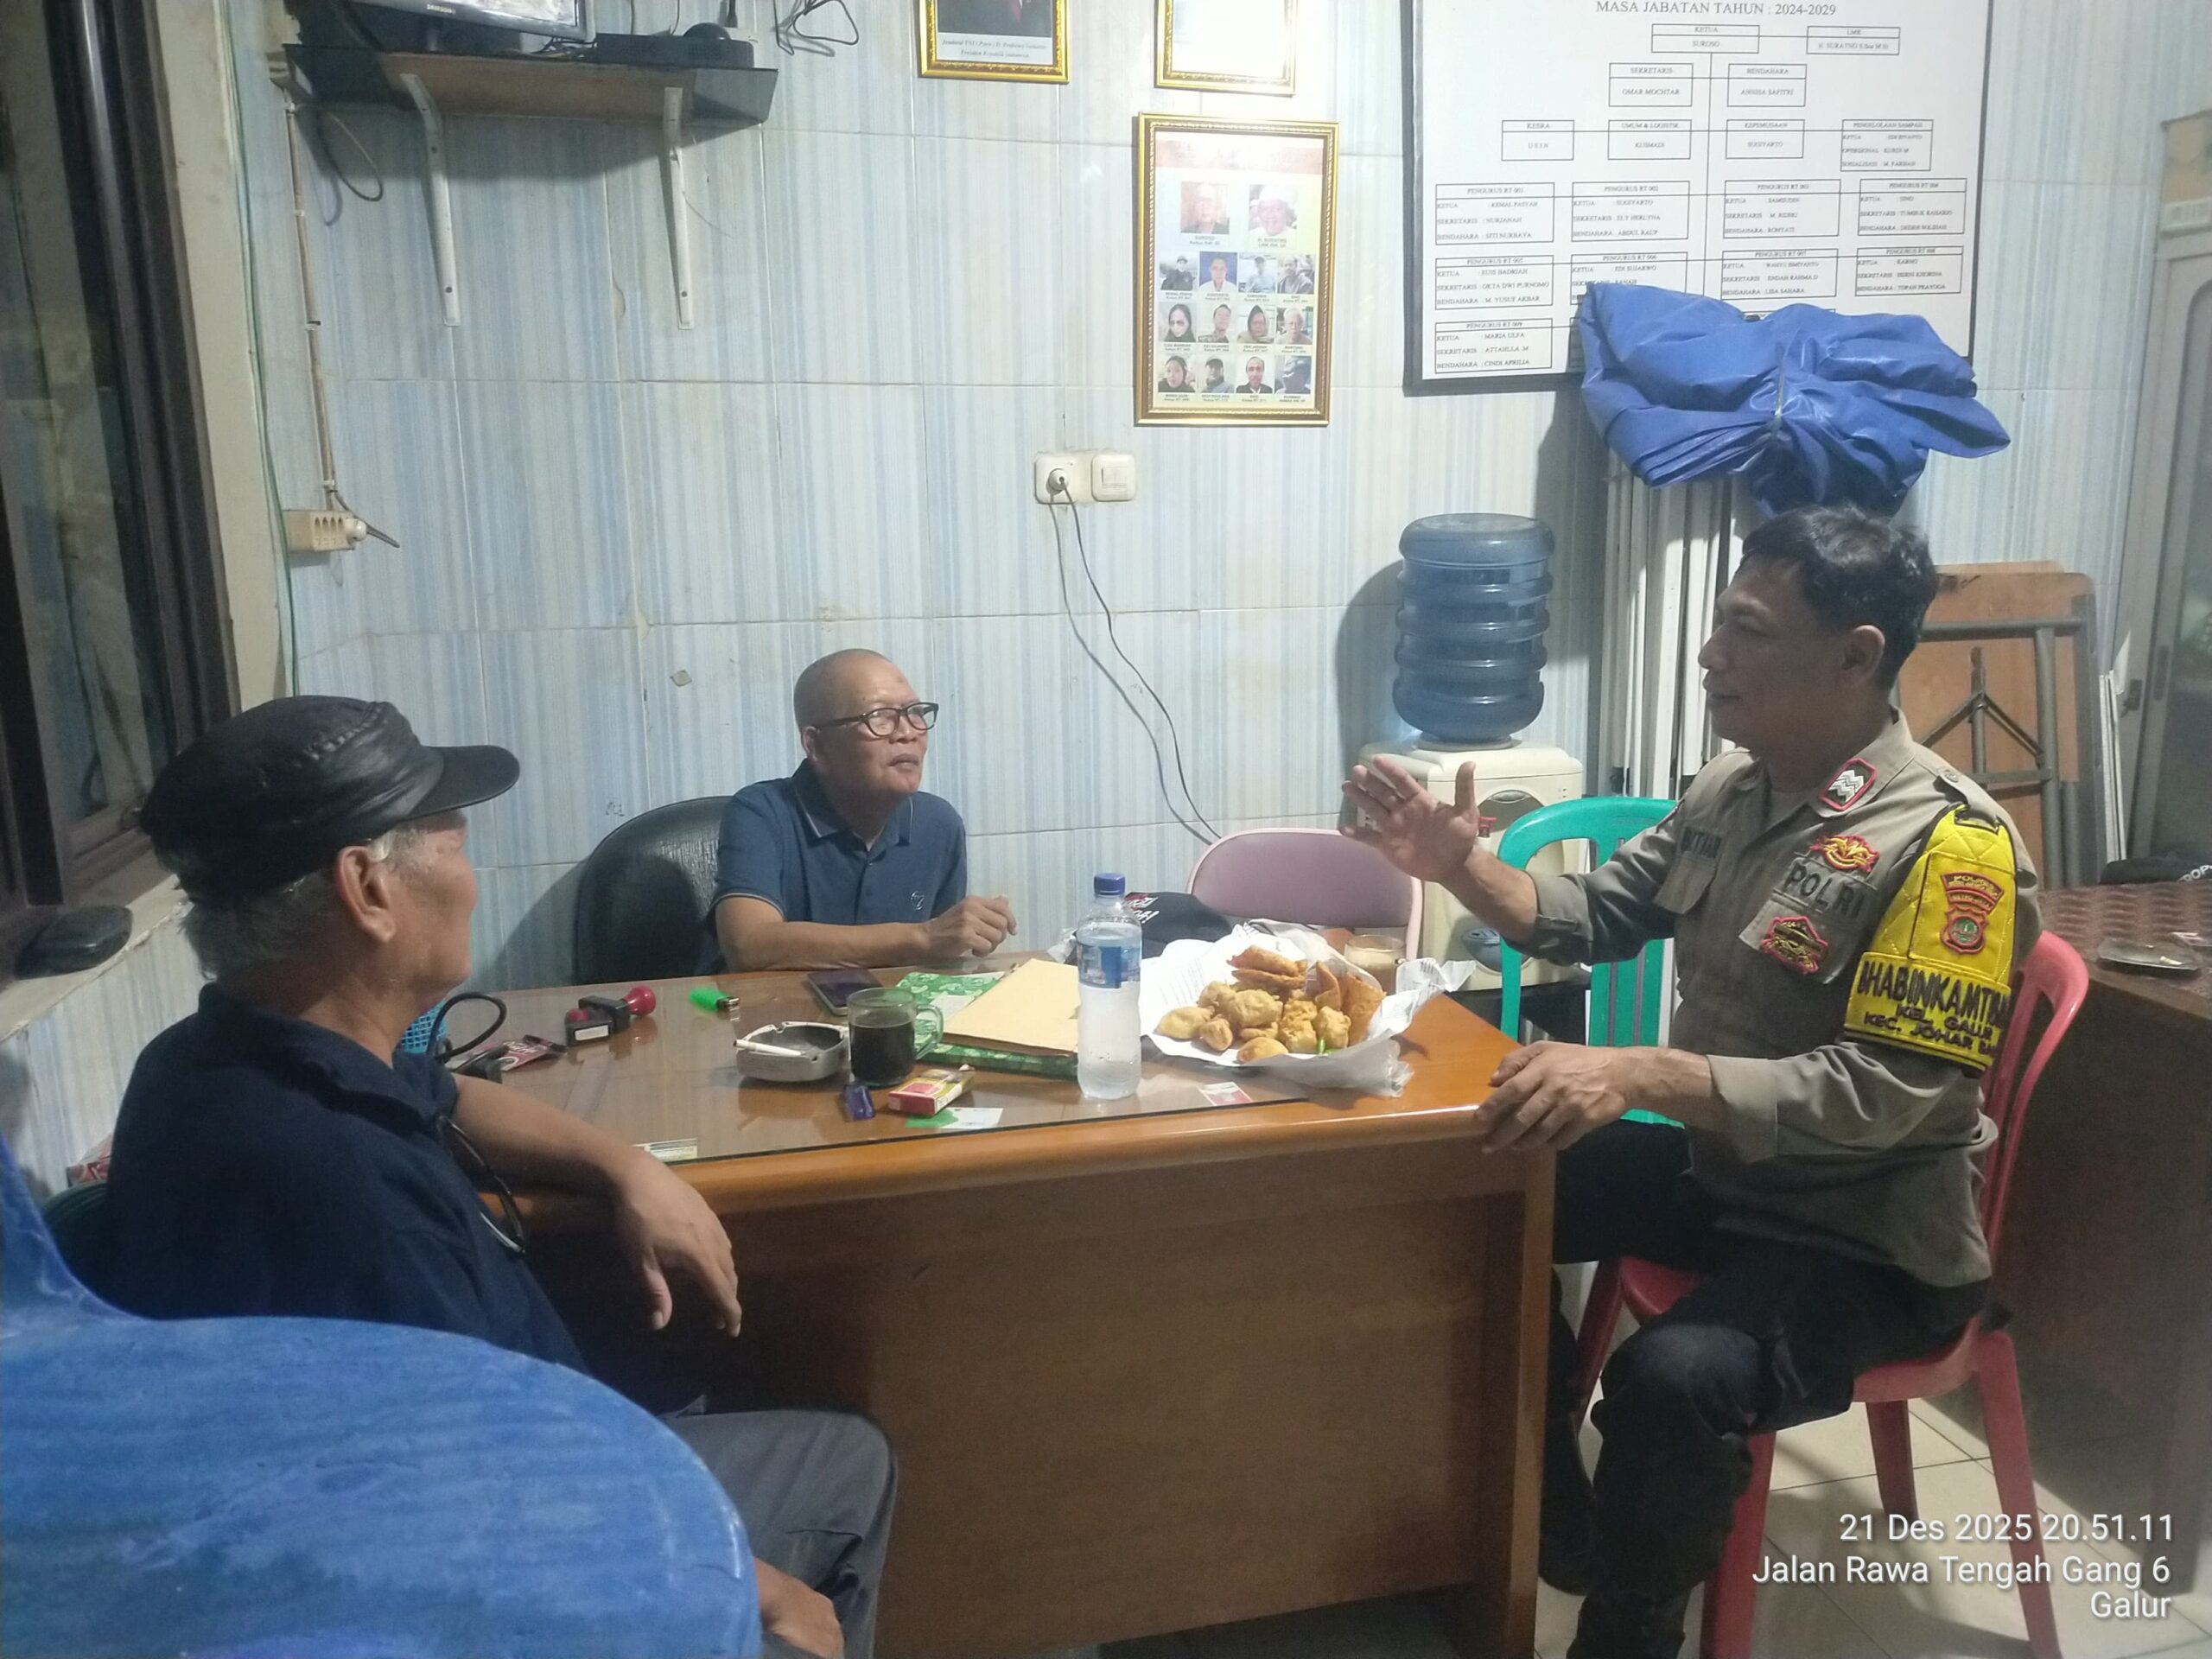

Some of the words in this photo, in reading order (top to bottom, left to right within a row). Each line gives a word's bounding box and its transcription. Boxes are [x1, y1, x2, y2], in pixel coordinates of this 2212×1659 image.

[1597, 1, 1638, 13] MASA
[1643, 1, 1709, 14] JABATAN
[1714, 2, 1764, 15] TAHUN
[1775, 3, 1836, 16] 2024-2029
[1783, 861, 1865, 918] POLRI
[1864, 1011, 1901, 1032] KEC.
